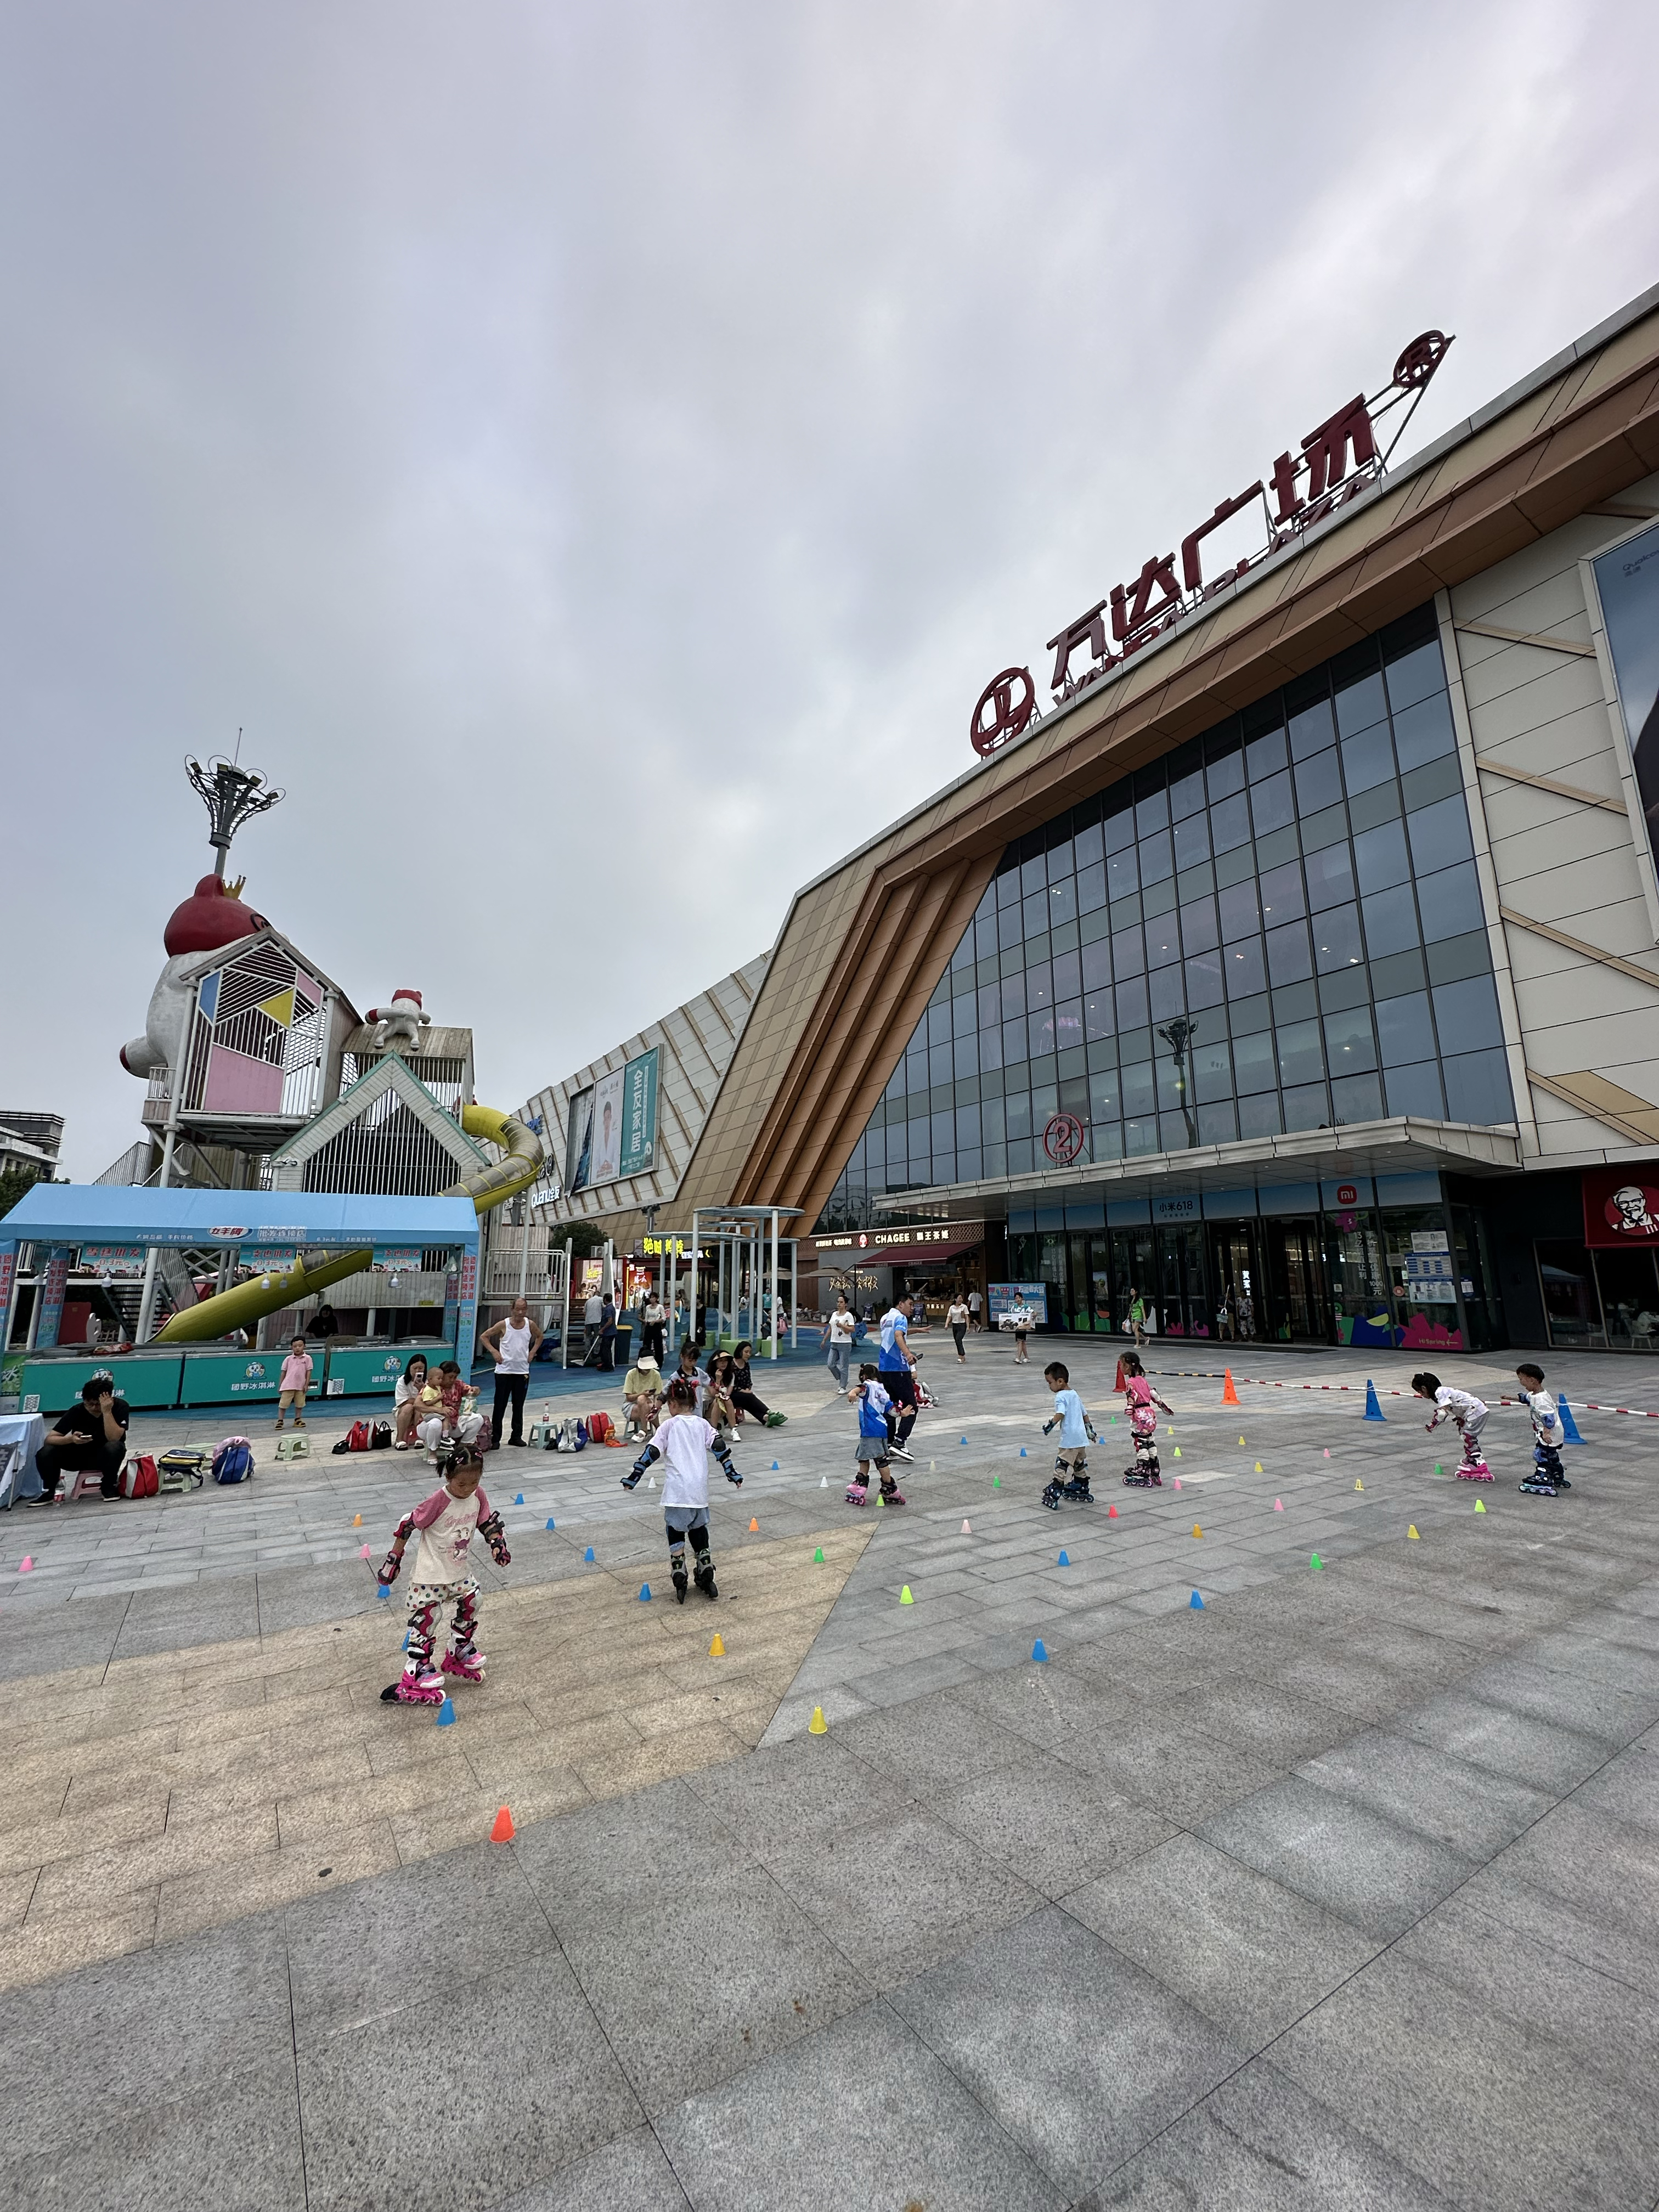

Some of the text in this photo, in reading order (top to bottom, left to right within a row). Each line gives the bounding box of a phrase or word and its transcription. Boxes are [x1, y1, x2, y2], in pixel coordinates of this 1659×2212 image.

[1047, 393, 1377, 689] 万达广场
[631, 1069, 643, 1153] 全友家居
[1159, 1200, 1193, 1212] 小米618
[876, 1233, 910, 1244] CHAGEE
[86, 1247, 141, 1257] 雪糕批发
